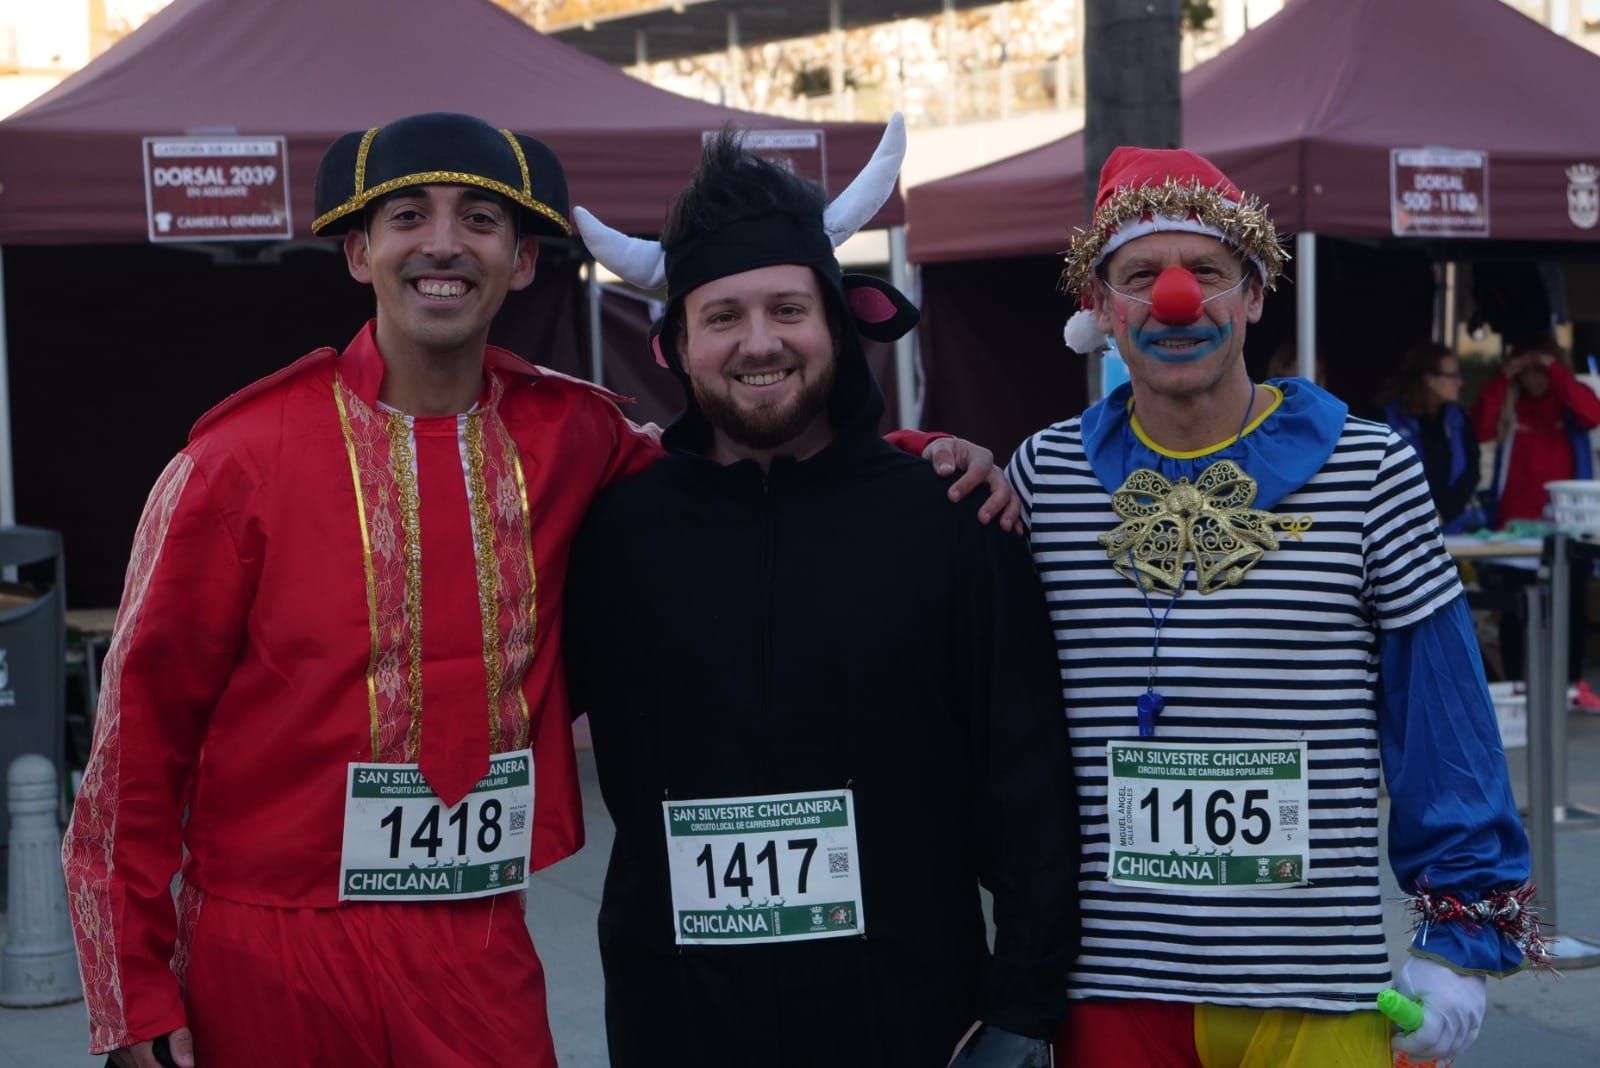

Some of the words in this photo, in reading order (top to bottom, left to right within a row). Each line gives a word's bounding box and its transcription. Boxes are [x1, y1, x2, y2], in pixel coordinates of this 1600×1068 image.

[154, 166, 227, 187] DORSAL
[229, 165, 277, 185] 2039
[1413, 174, 1464, 190] DORSAL
[177, 216, 229, 229] CAMISETA
[1117, 749, 1143, 763] SAN
[1147, 752, 1208, 766] SILVESTRE
[1212, 752, 1297, 767] CHICLANERA
[358, 771, 388, 784] SAN
[392, 772, 426, 784] SILVE
[485, 760, 526, 777] ANERA
[1138, 765, 1166, 775] CIRCUITO
[1166, 766, 1187, 776] LOCAL
[1188, 767, 1198, 776] DE
[1198, 767, 1234, 777] CARRERAS
[1235, 767, 1274, 776] POPULARES
[380, 785, 411, 795] CIRCUITO
[673, 808, 696, 821] SAN
[699, 805, 755, 820] SILVESTRE
[758, 799, 843, 818] CHICLANERA
[1140, 787, 1271, 846] 1165
[380, 799, 502, 858] 1418
[691, 822, 715, 831] CIRCUITO
[716, 821, 735, 831] LOCAL
[736, 821, 745, 829] DE
[745, 818, 779, 829] CARRERAS
[781, 816, 820, 827] POPULARES
[1119, 815, 1128, 847] MIGUEL
[696, 838, 818, 899] 1417
[1117, 856, 1214, 880] CHICLANA
[349, 873, 450, 891] CHICLANA
[683, 913, 768, 933] CHICLANA
